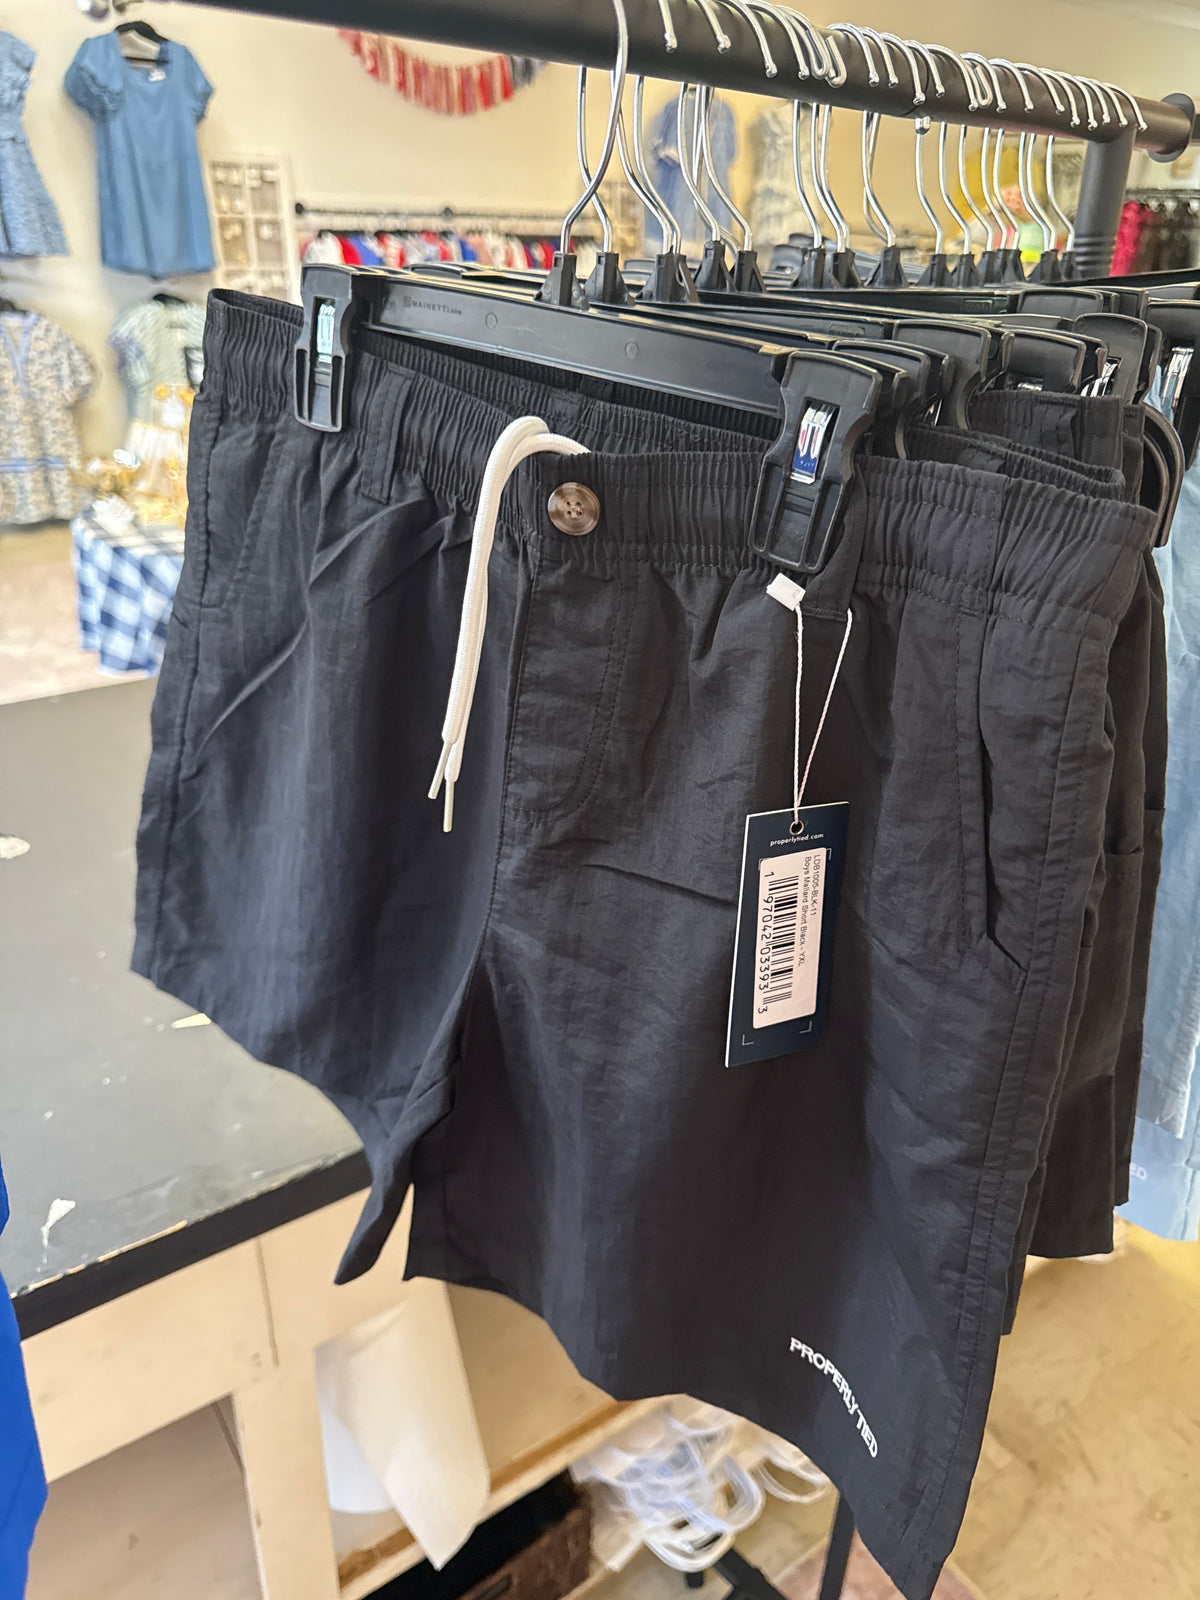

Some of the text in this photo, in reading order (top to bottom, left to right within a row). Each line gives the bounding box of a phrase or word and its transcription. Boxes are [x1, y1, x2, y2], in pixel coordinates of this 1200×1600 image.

[769, 833, 824, 847] properlytied.com
[803, 856, 812, 875] Boys
[801, 876, 811, 904] Mallard
[811, 854, 821, 916] LDB1005-BLK-11
[800, 905, 809, 925] Short
[757, 870, 775, 1014] 1 97042 03393 3
[799, 926, 808, 946] Black
[798, 952, 806, 967] YXL
[790, 1337, 878, 1458] PROPERLY TIED
